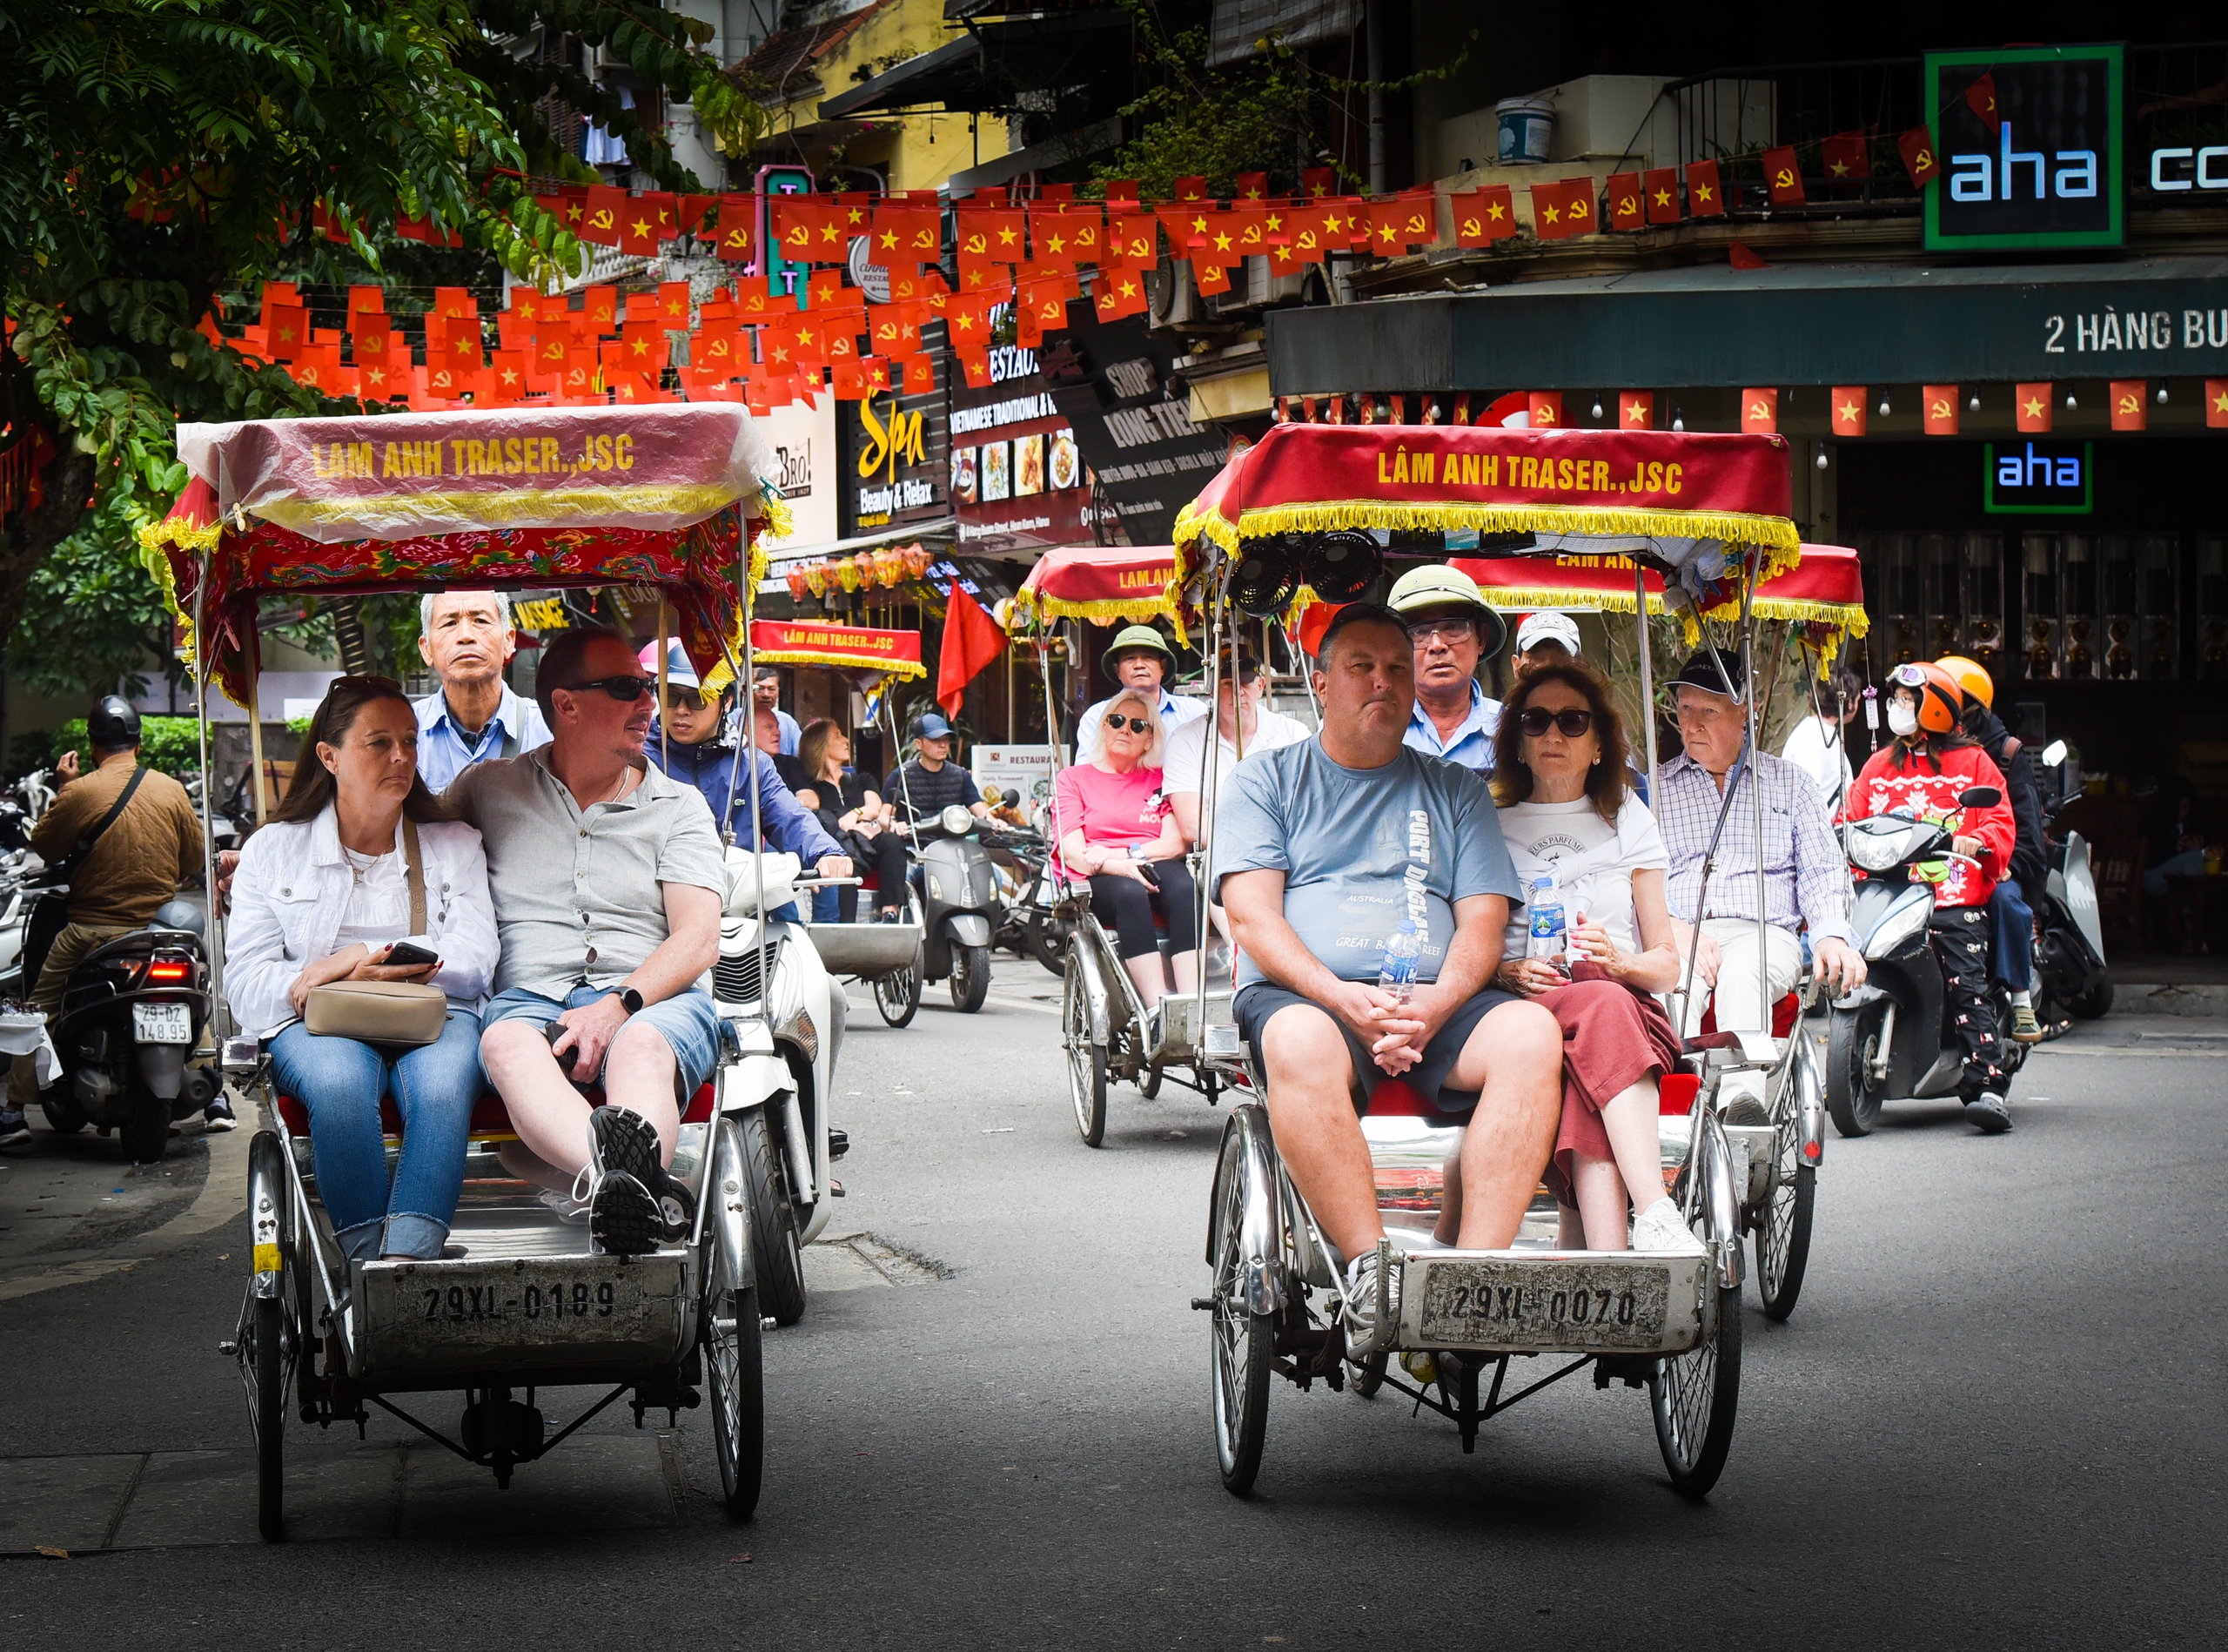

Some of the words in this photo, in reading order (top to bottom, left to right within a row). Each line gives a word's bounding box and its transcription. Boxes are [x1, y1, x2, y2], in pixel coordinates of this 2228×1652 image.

[1951, 121, 2097, 202] aha
[2044, 315, 2066, 353] 2
[2077, 305, 2172, 352] HÀNG
[1105, 359, 1152, 399] SHOP
[950, 405, 993, 434] VIETNAMESE
[993, 394, 1039, 426] TRADITIONAL
[1039, 392, 1047, 417] &
[1103, 406, 1162, 448] LONG
[858, 384, 926, 485] Spa
[383, 440, 442, 478] ANH
[1378, 445, 1434, 484] LÂM
[1442, 453, 1500, 487] ANH
[1999, 441, 2079, 487] aha
[860, 485, 893, 516] Beauty
[894, 482, 902, 510] &
[903, 479, 932, 508] Relax
[514, 598, 570, 631] MASSAGE
[783, 628, 805, 643] LÂM
[806, 633, 828, 645] ANH
[1408, 809, 1431, 865] PORT
[1346, 894, 1393, 906] AUSTRALIA
[1335, 936, 1371, 949] GREAT
[1422, 944, 1441, 957] REEF
[139, 1024, 187, 1040] 148.95
[143, 1005, 181, 1023] 29-D2
[424, 1282, 614, 1322] 29XL-0189
